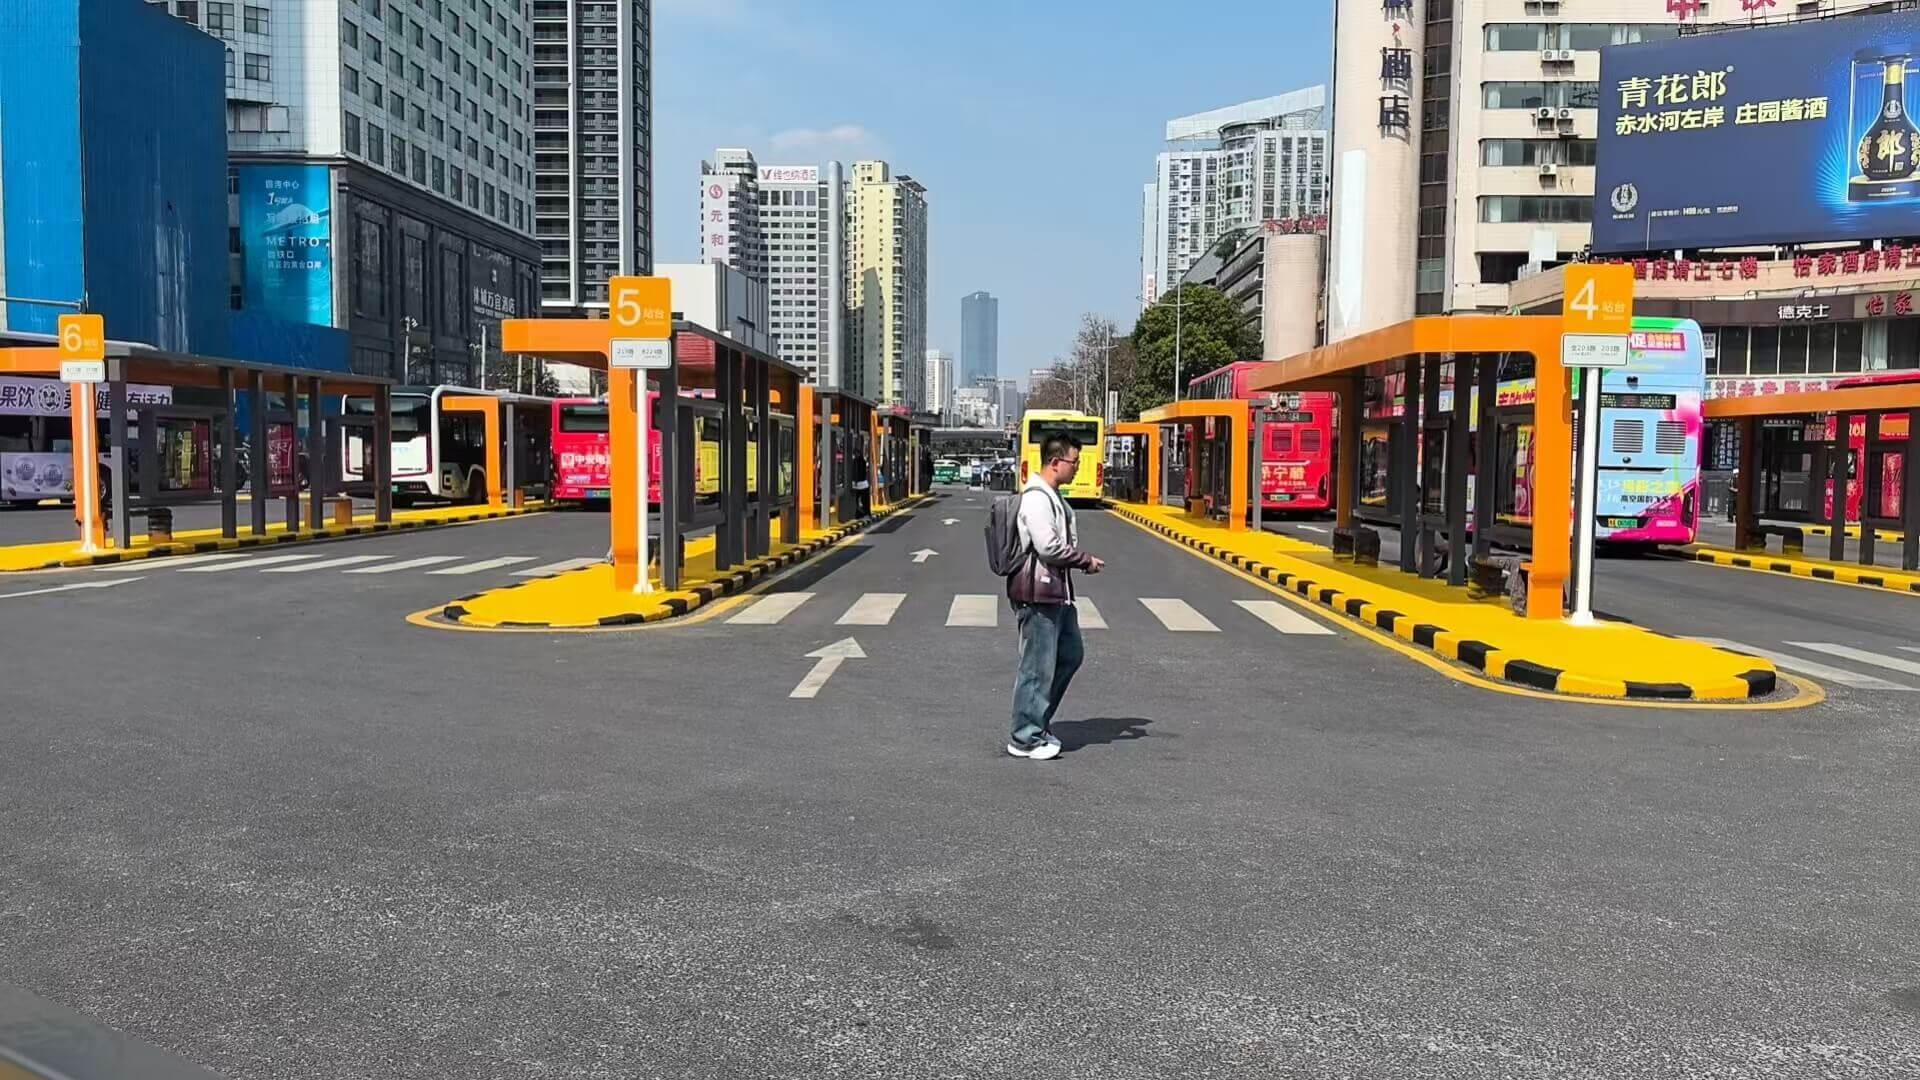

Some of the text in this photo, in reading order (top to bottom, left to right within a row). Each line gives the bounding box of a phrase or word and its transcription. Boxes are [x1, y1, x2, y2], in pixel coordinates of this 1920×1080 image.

[1616, 69, 1727, 109] 青花郎
[1615, 96, 1828, 136] 赤水河左岸 庄园酱酒
[266, 236, 320, 248] METRO
[616, 288, 641, 327] 5
[1570, 279, 1599, 321] 4
[1778, 304, 1830, 320] 德克士
[63, 323, 82, 352] 6
[2, 386, 35, 408] 果饮
